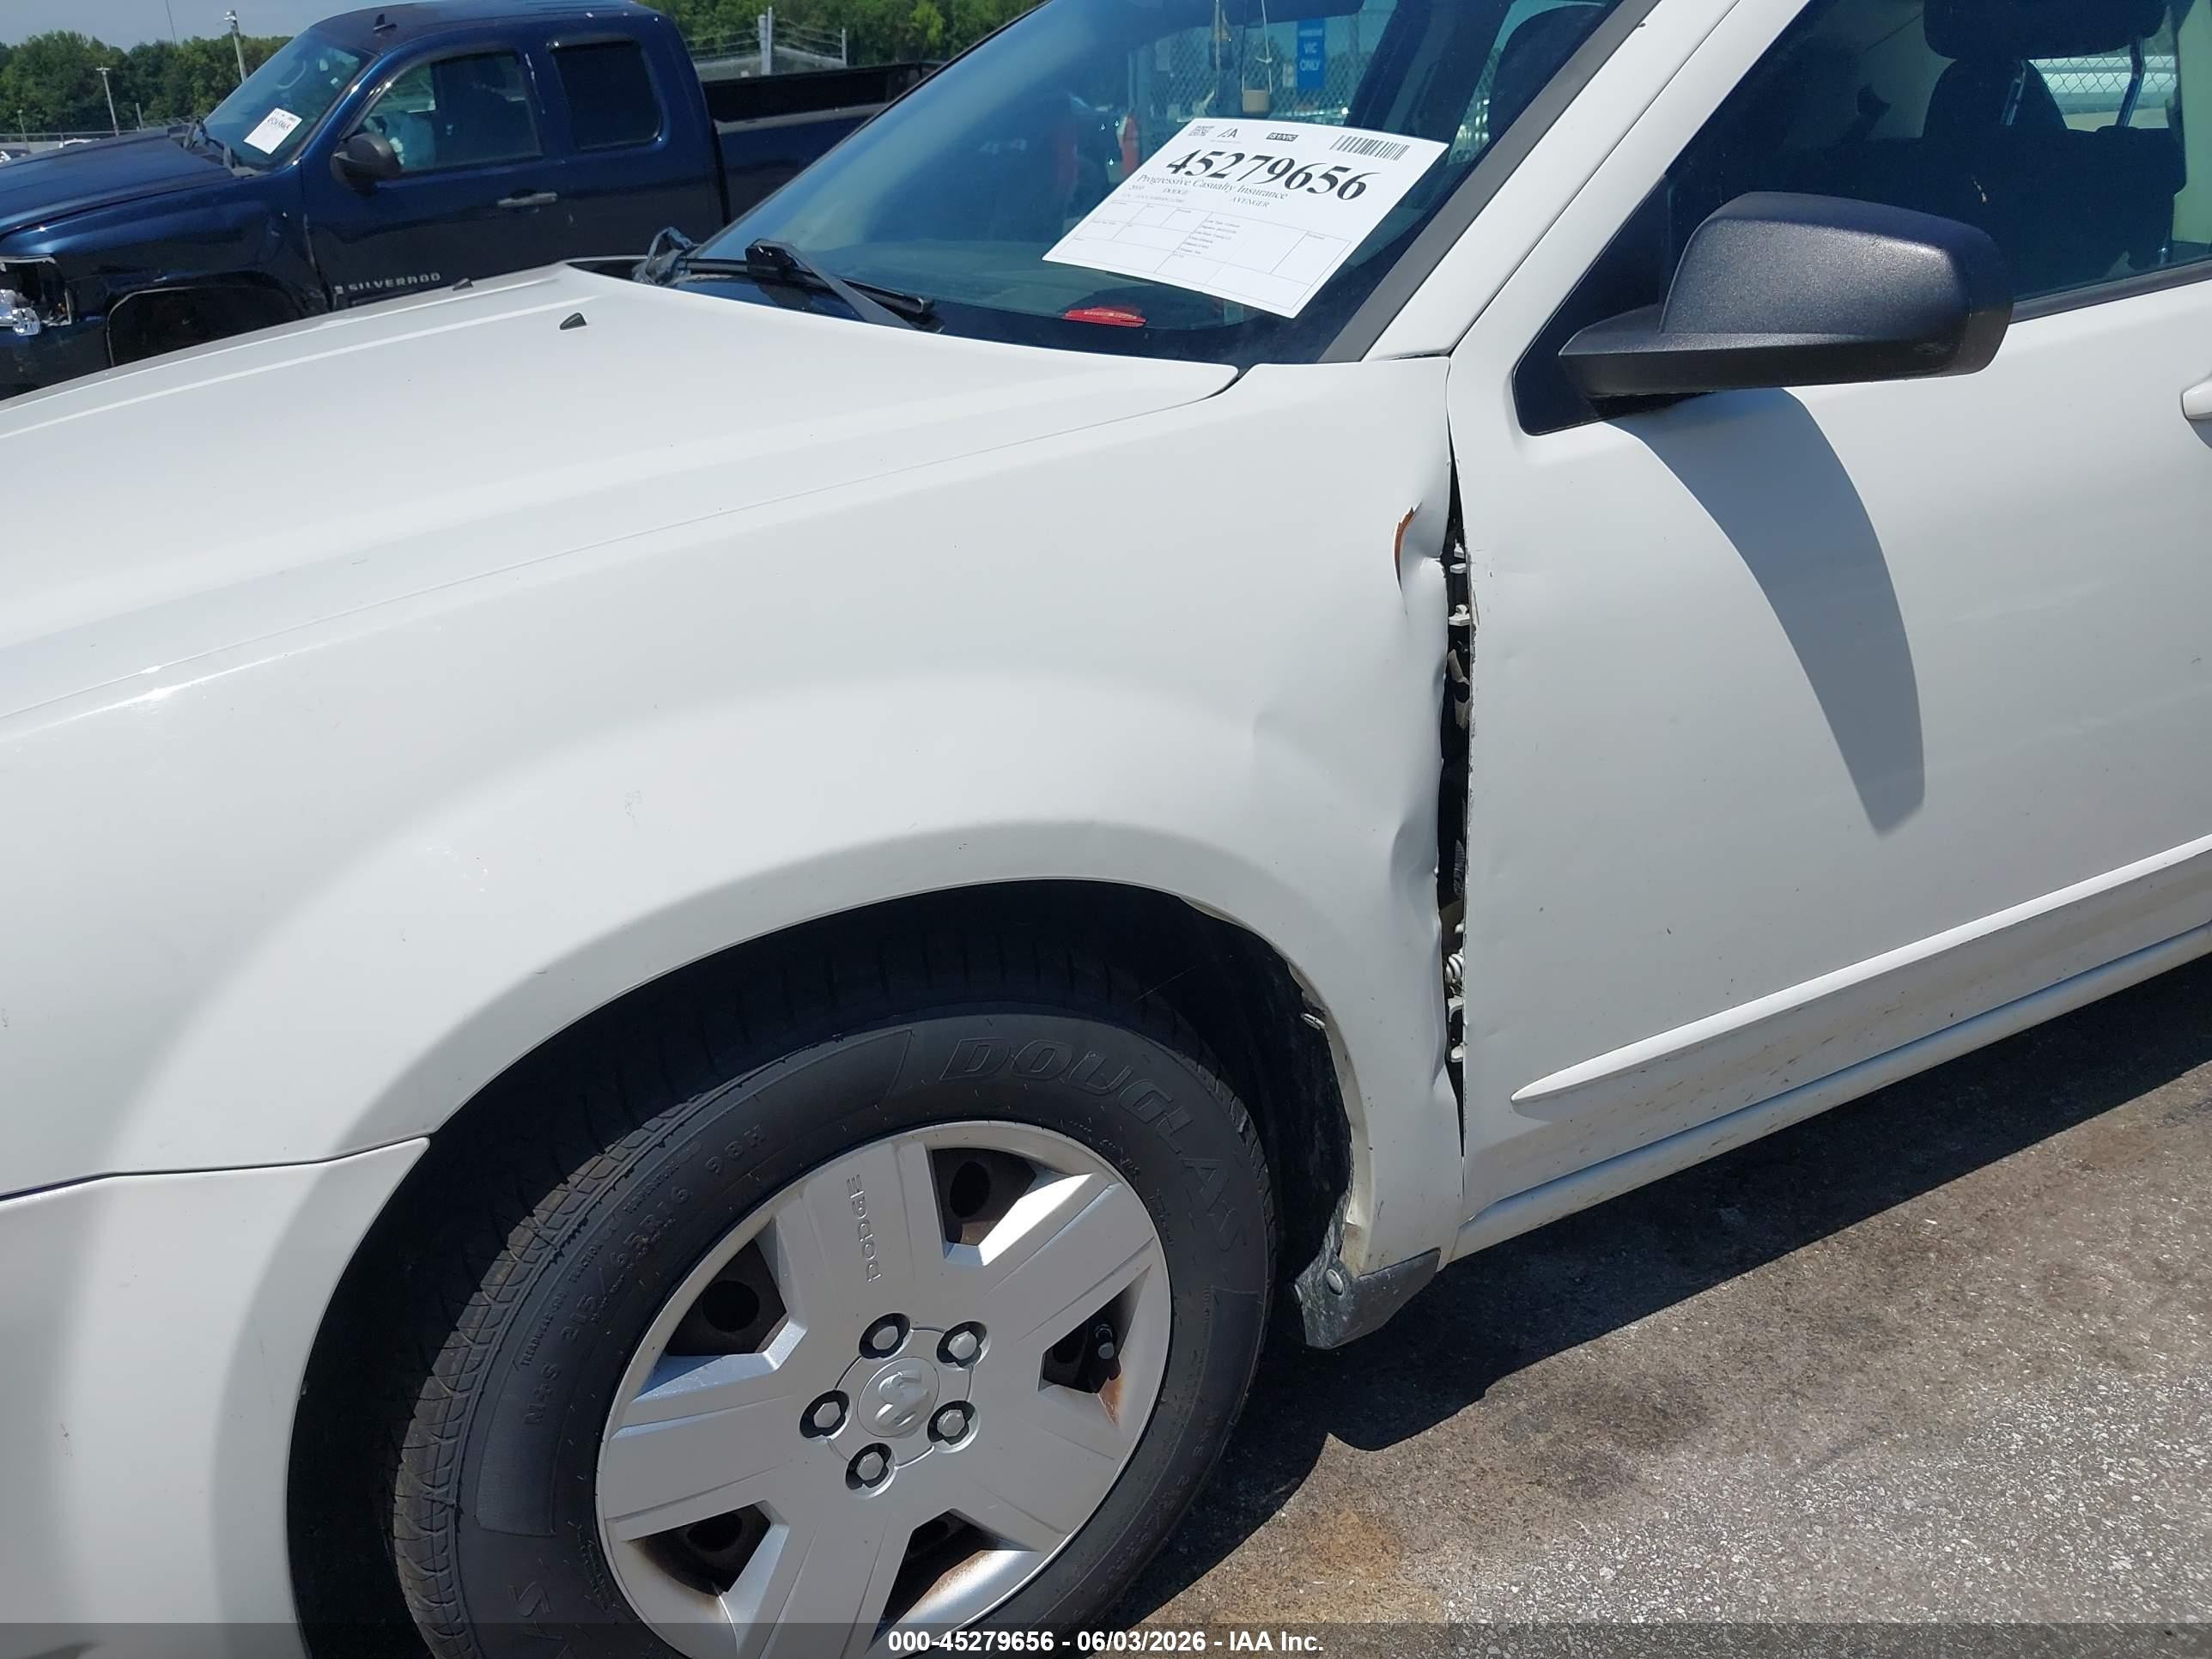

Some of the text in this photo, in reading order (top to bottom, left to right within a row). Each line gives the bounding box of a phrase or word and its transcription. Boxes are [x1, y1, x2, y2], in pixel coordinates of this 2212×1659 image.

[1137, 174, 1289, 200] Progressive Casualty Insurance
[1165, 149, 1382, 201] 45279656
[1230, 197, 1271, 209] AVENGER
[349, 271, 441, 290] SILVERADO
[939, 1037, 1243, 1252] DOUGLAS
[846, 1173, 883, 1283] DODGE
